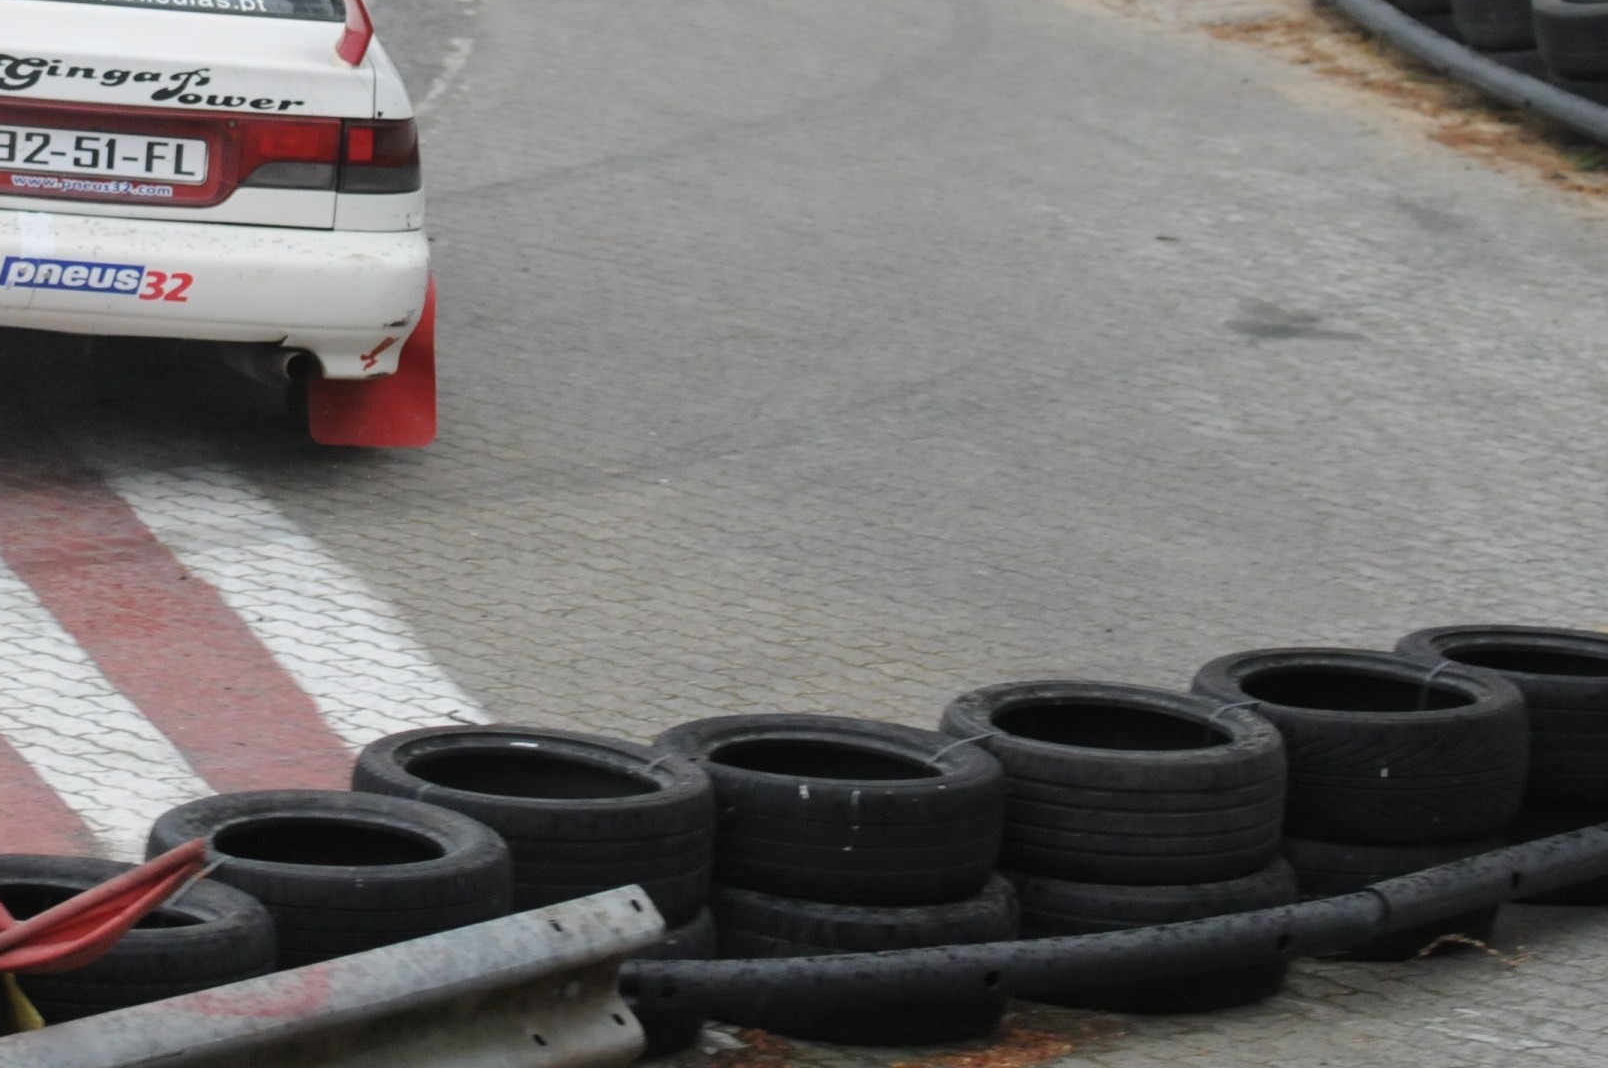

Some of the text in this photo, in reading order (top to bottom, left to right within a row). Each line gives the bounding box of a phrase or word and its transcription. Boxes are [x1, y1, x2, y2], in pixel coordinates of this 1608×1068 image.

[150, 68, 305, 111] Power
[11, 175, 173, 197] www.pneus32.com
[4, 257, 195, 303] pneus32
